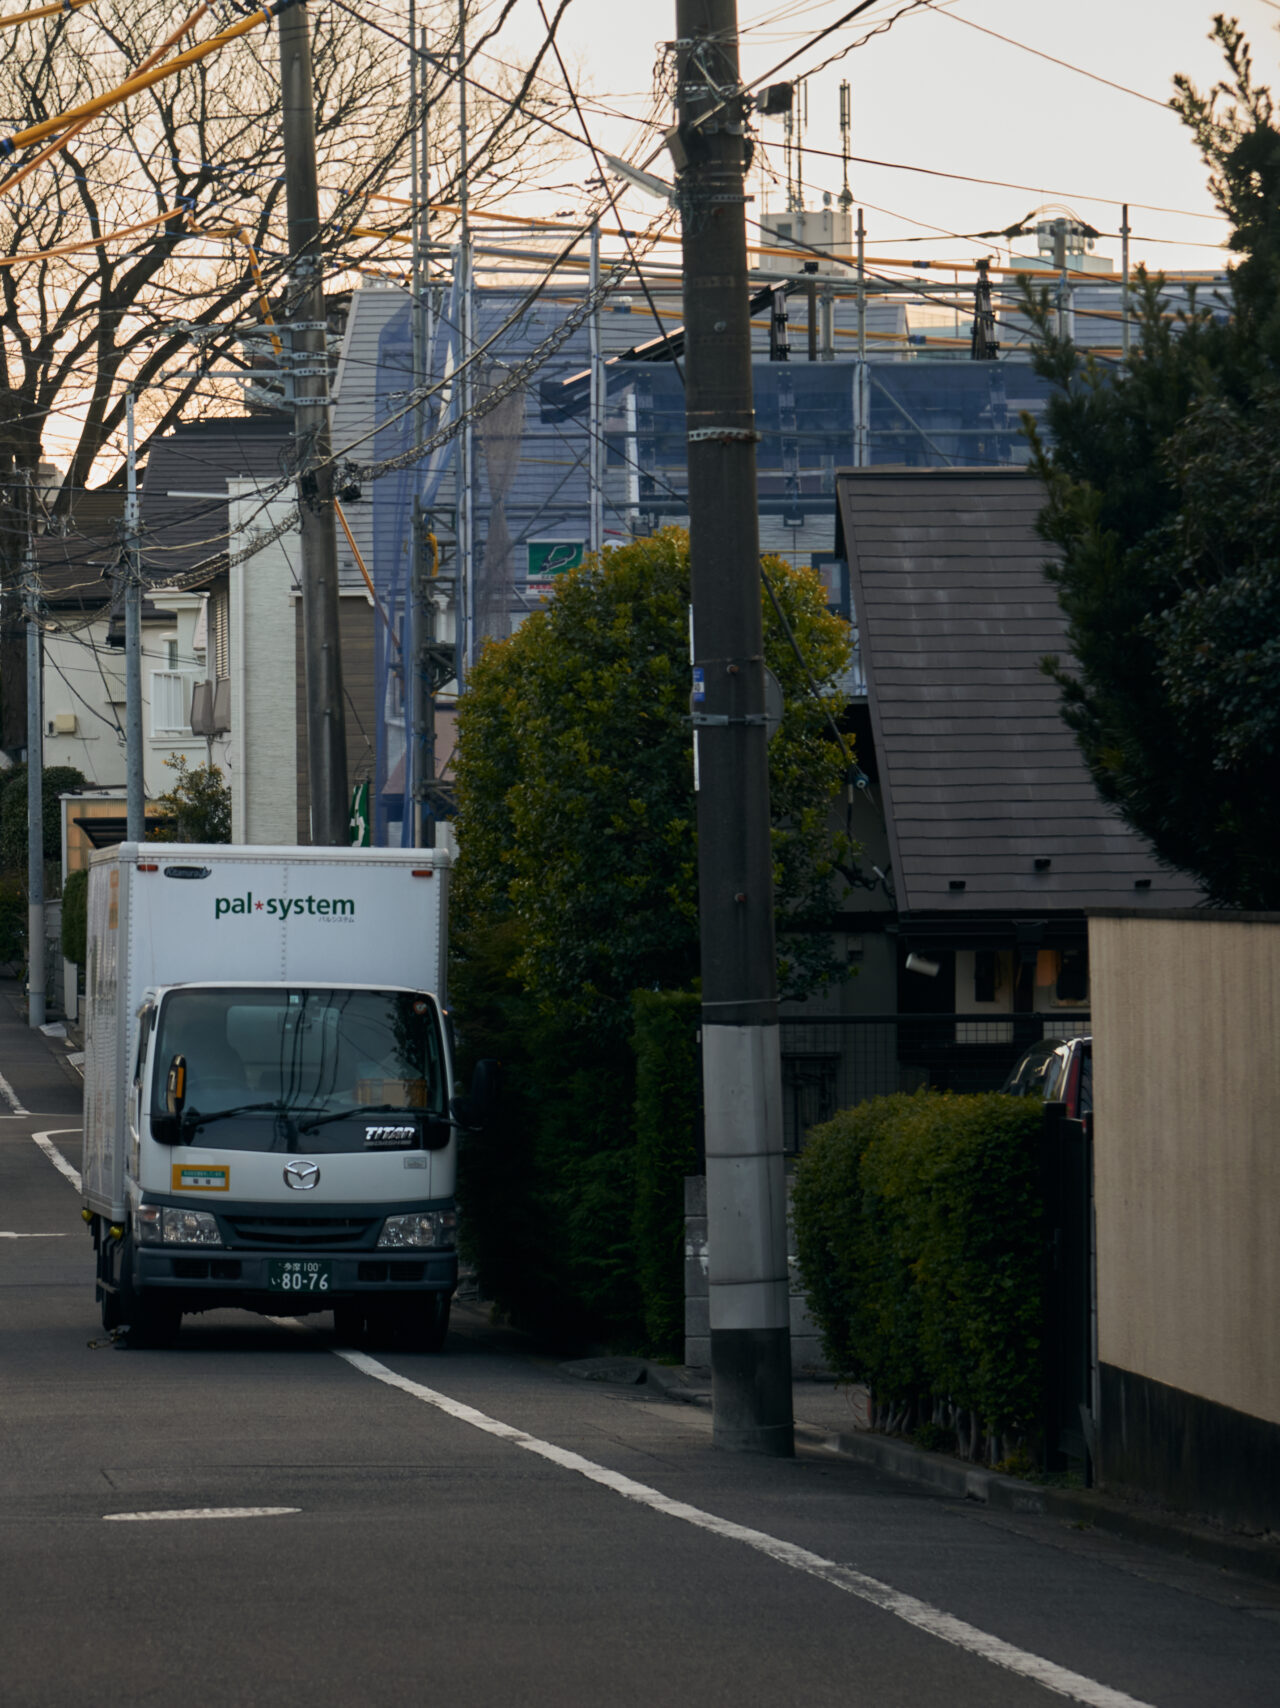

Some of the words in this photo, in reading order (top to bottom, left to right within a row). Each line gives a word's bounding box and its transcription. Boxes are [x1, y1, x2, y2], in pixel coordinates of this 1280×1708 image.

[266, 895, 355, 920] system
[365, 1126, 415, 1140] TITAN
[303, 1262, 319, 1272] 100
[282, 1273, 328, 1290] 80-76
